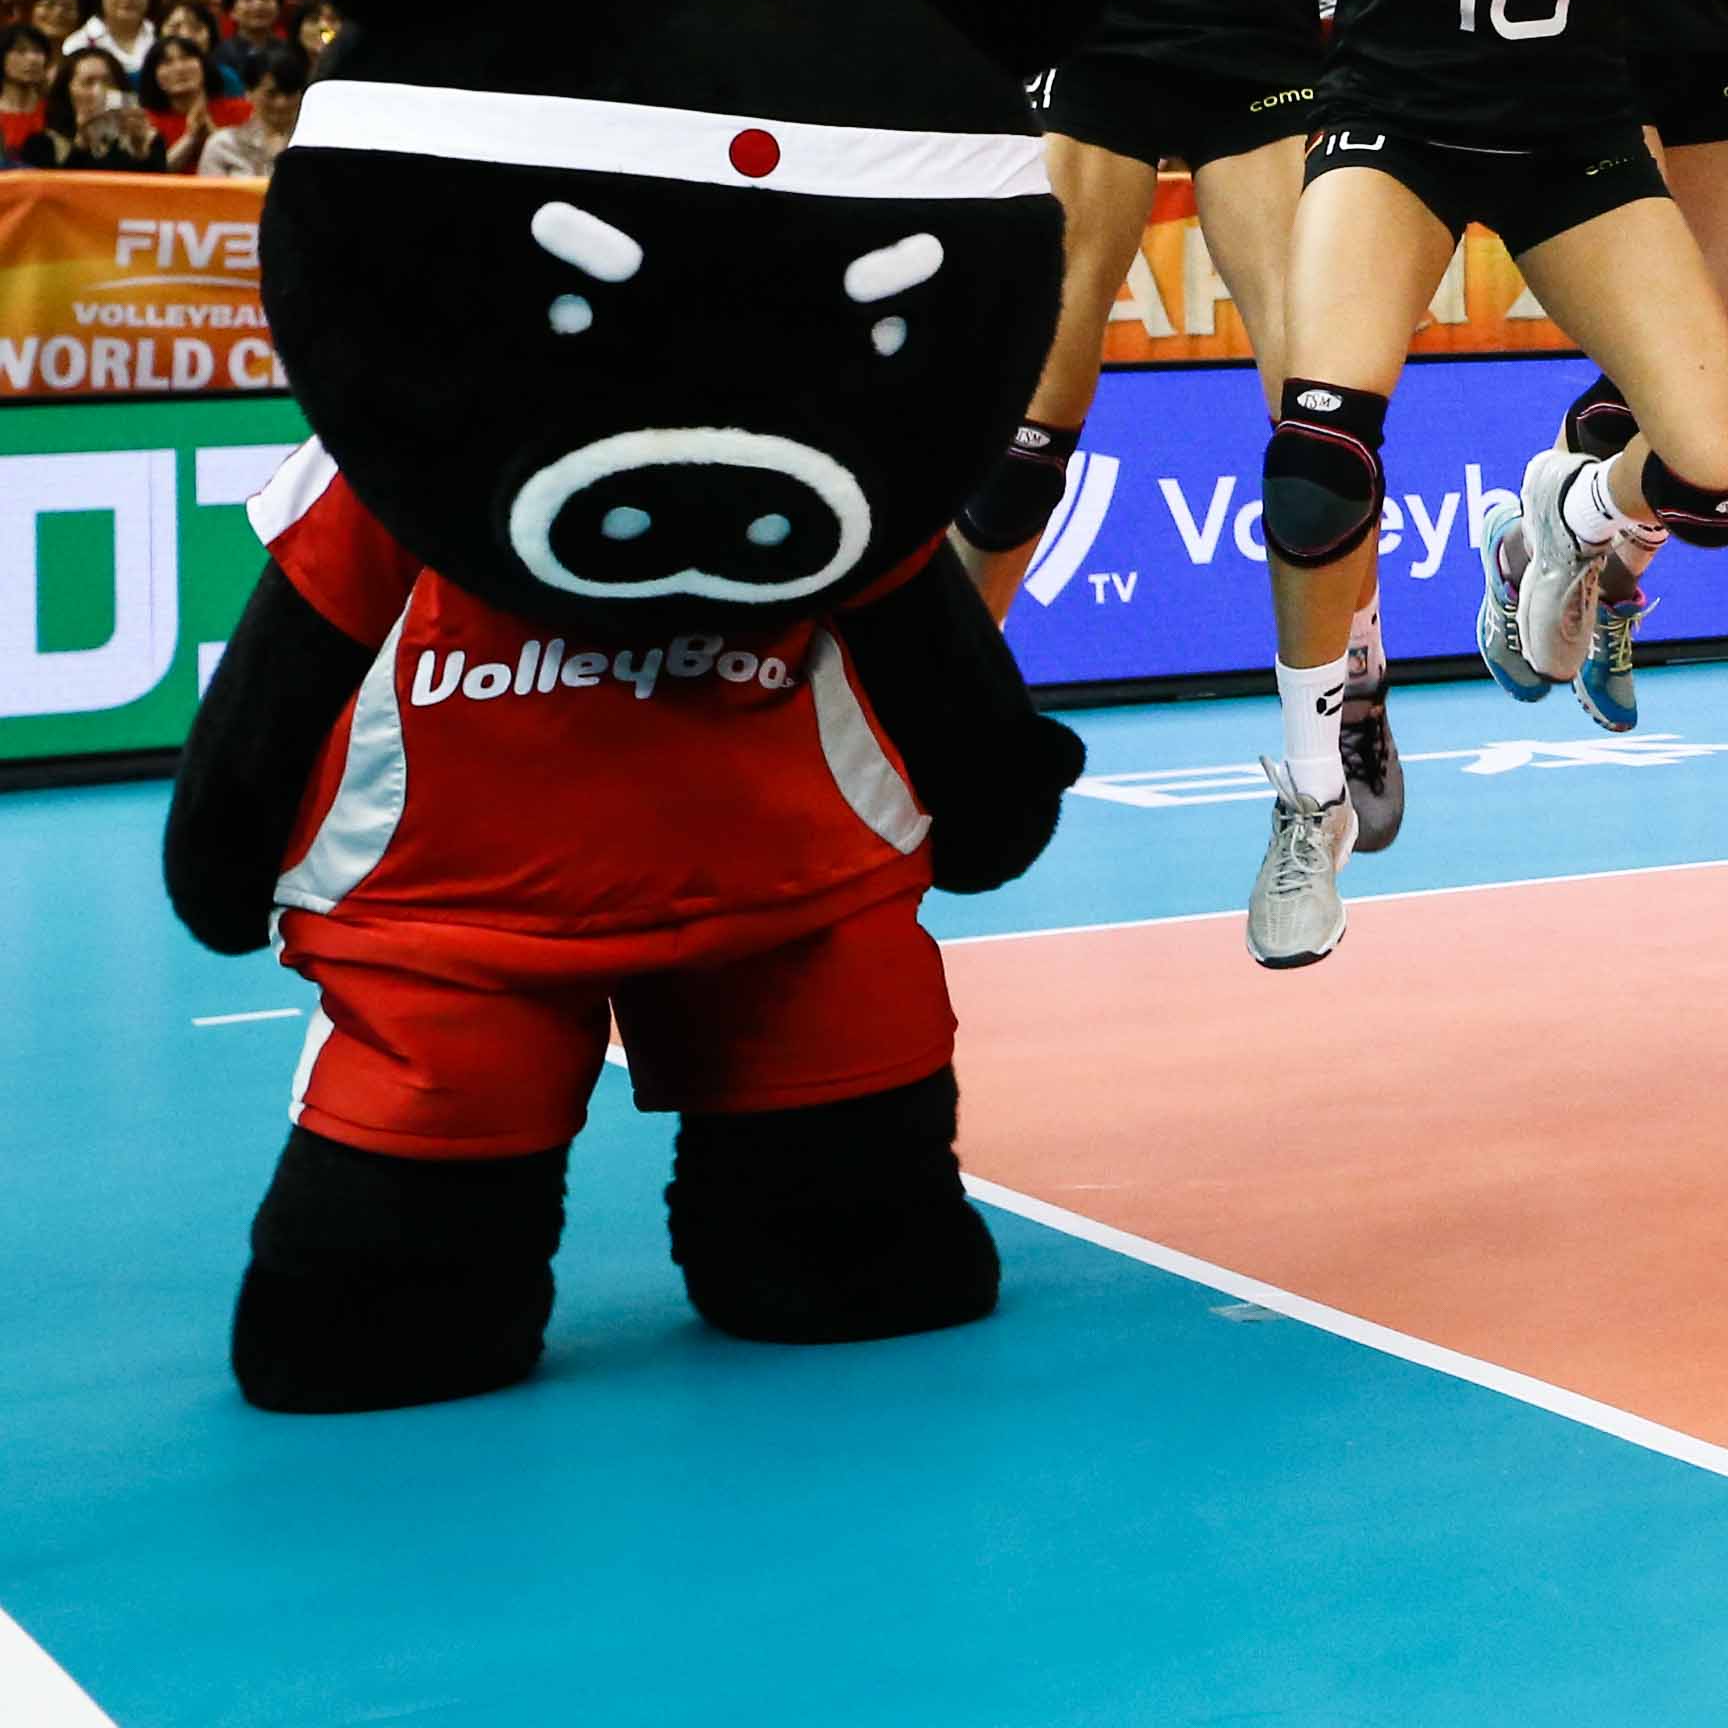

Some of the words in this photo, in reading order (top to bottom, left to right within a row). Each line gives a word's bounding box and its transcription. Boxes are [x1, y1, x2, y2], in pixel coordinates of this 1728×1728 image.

[115, 218, 261, 270] FIVB
[0, 337, 215, 390] WORLD
[1088, 572, 1138, 604] TV
